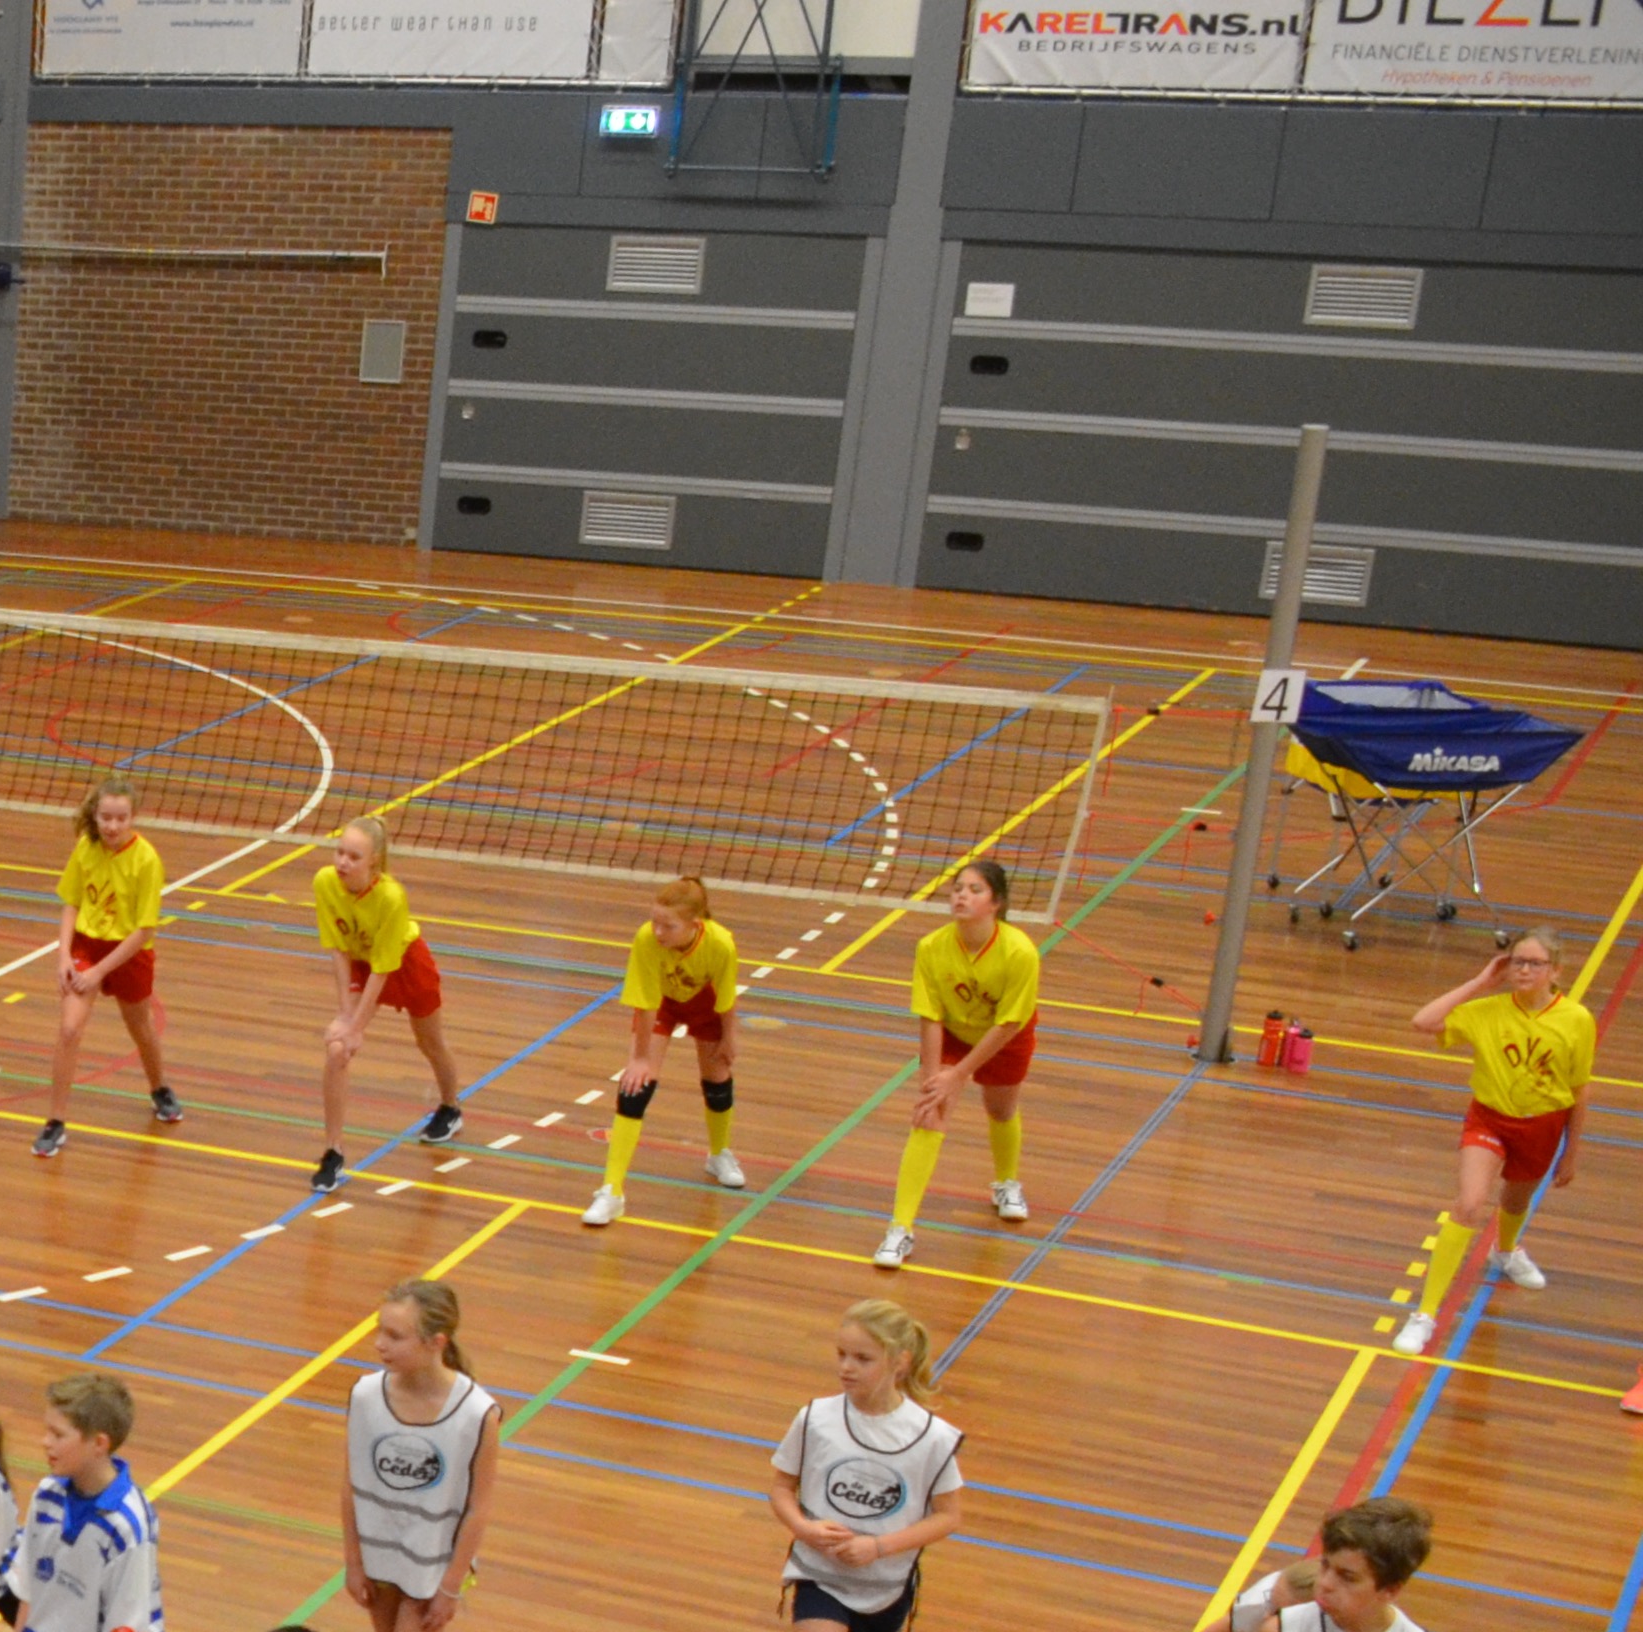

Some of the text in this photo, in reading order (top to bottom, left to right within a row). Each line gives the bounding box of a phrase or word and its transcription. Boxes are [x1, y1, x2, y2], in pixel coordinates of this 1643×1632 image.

[979, 11, 1301, 36] KARELTRANS.nl
[1017, 39, 1258, 55] BEDRIJFSWAGENS
[1331, 41, 1450, 61] FINANCIËLE
[1381, 68, 1476, 86] Hypotheken
[1483, 71, 1493, 85] &
[1260, 677, 1290, 720] 4
